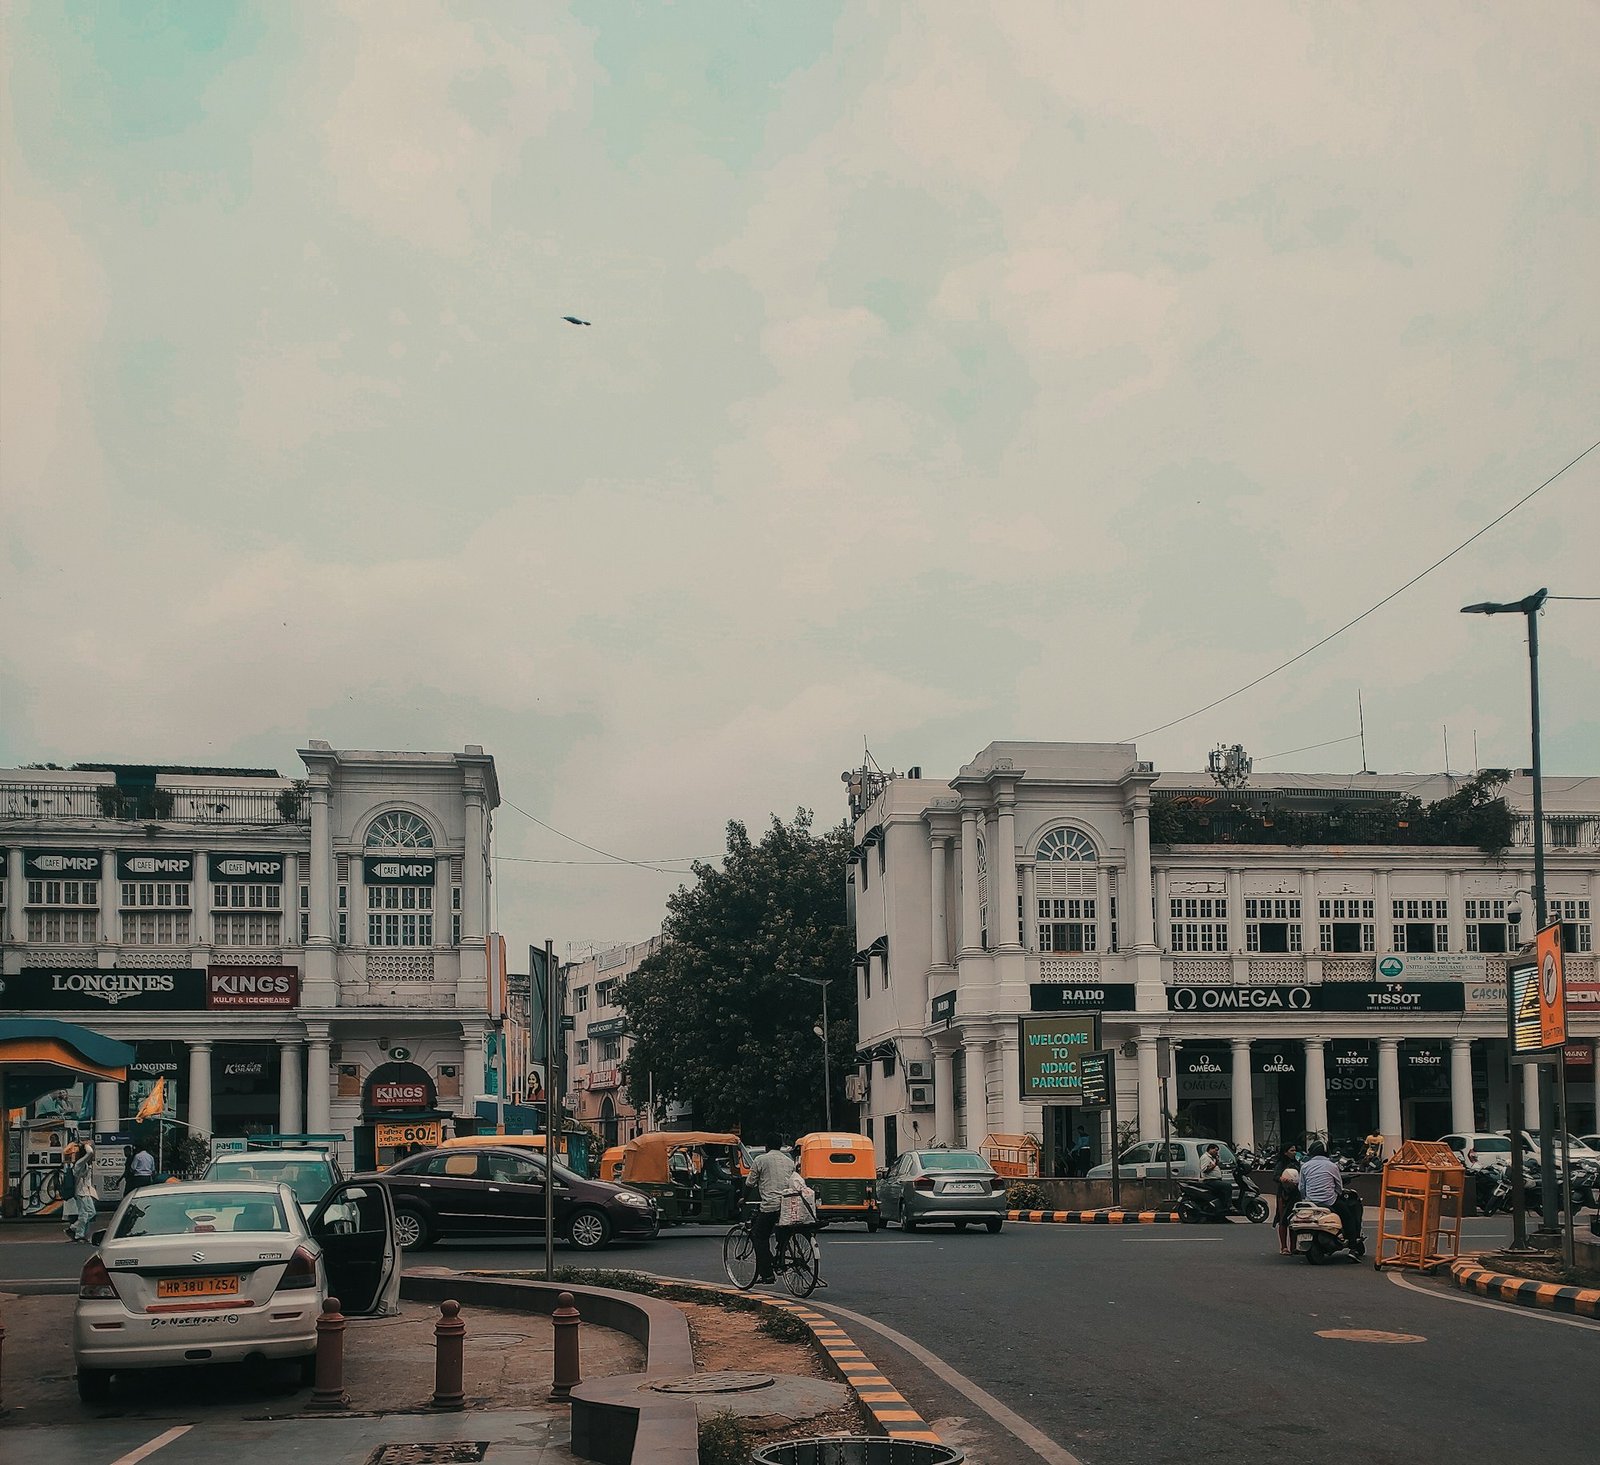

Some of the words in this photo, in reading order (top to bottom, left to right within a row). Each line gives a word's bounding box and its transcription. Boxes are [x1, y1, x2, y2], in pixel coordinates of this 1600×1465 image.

[44, 858, 60, 867] CAFE
[63, 857, 98, 870] MRP
[137, 861, 152, 869] CAFE
[155, 859, 190, 872] MRP
[228, 863, 243, 872] CAFE
[246, 861, 281, 875] MRP
[383, 866, 397, 875] CAFE
[400, 865, 433, 877] MRP
[52, 974, 175, 991] LONGINES
[211, 975, 290, 994] KINGS
[1062, 990, 1104, 1000] RADO
[1202, 989, 1283, 1008] OMEGA
[1367, 994, 1421, 1004] TISSOT
[1029, 1033, 1088, 1045] WELCOME
[395, 1049, 404, 1059] C
[1051, 1047, 1068, 1059] TO
[1408, 1056, 1441, 1064] TISSOT
[130, 1063, 178, 1071] LONGINES
[1041, 1062, 1077, 1074] NDMC
[1189, 1064, 1222, 1072] OMEGA
[1263, 1064, 1295, 1072] OMEGA
[1326, 1078, 1377, 1090] ISSOT
[376, 1087, 423, 1099] KINGS
[166, 1281, 179, 1293] HR
[150, 1317, 167, 1327] Do
[169, 1317, 191, 1326] Not
[193, 1316, 220, 1325] Honk
